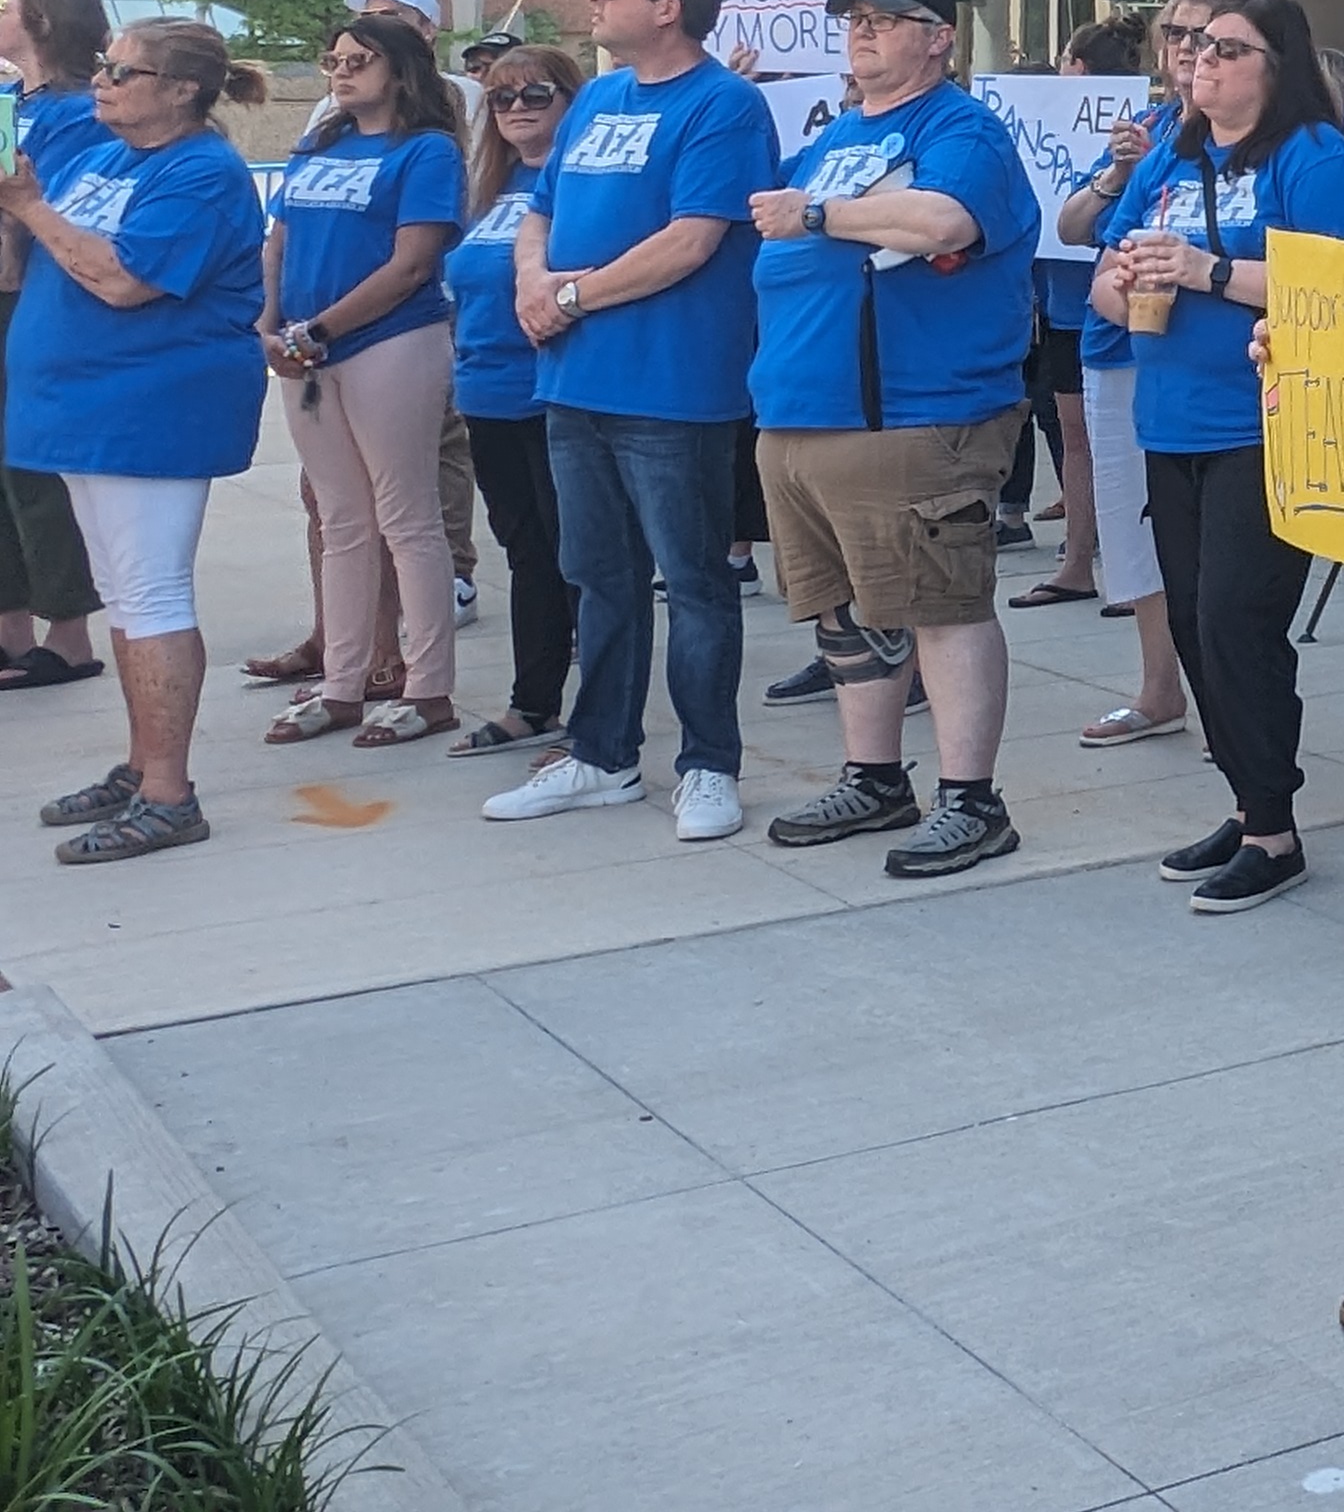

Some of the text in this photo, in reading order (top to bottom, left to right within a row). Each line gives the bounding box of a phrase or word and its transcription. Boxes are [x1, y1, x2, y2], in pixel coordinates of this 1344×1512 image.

[713, 10, 842, 54] YMORE
[1072, 96, 1134, 134] AEA
[565, 122, 659, 167] AEA
[284, 164, 380, 206] AEA
[463, 201, 529, 240] AE
